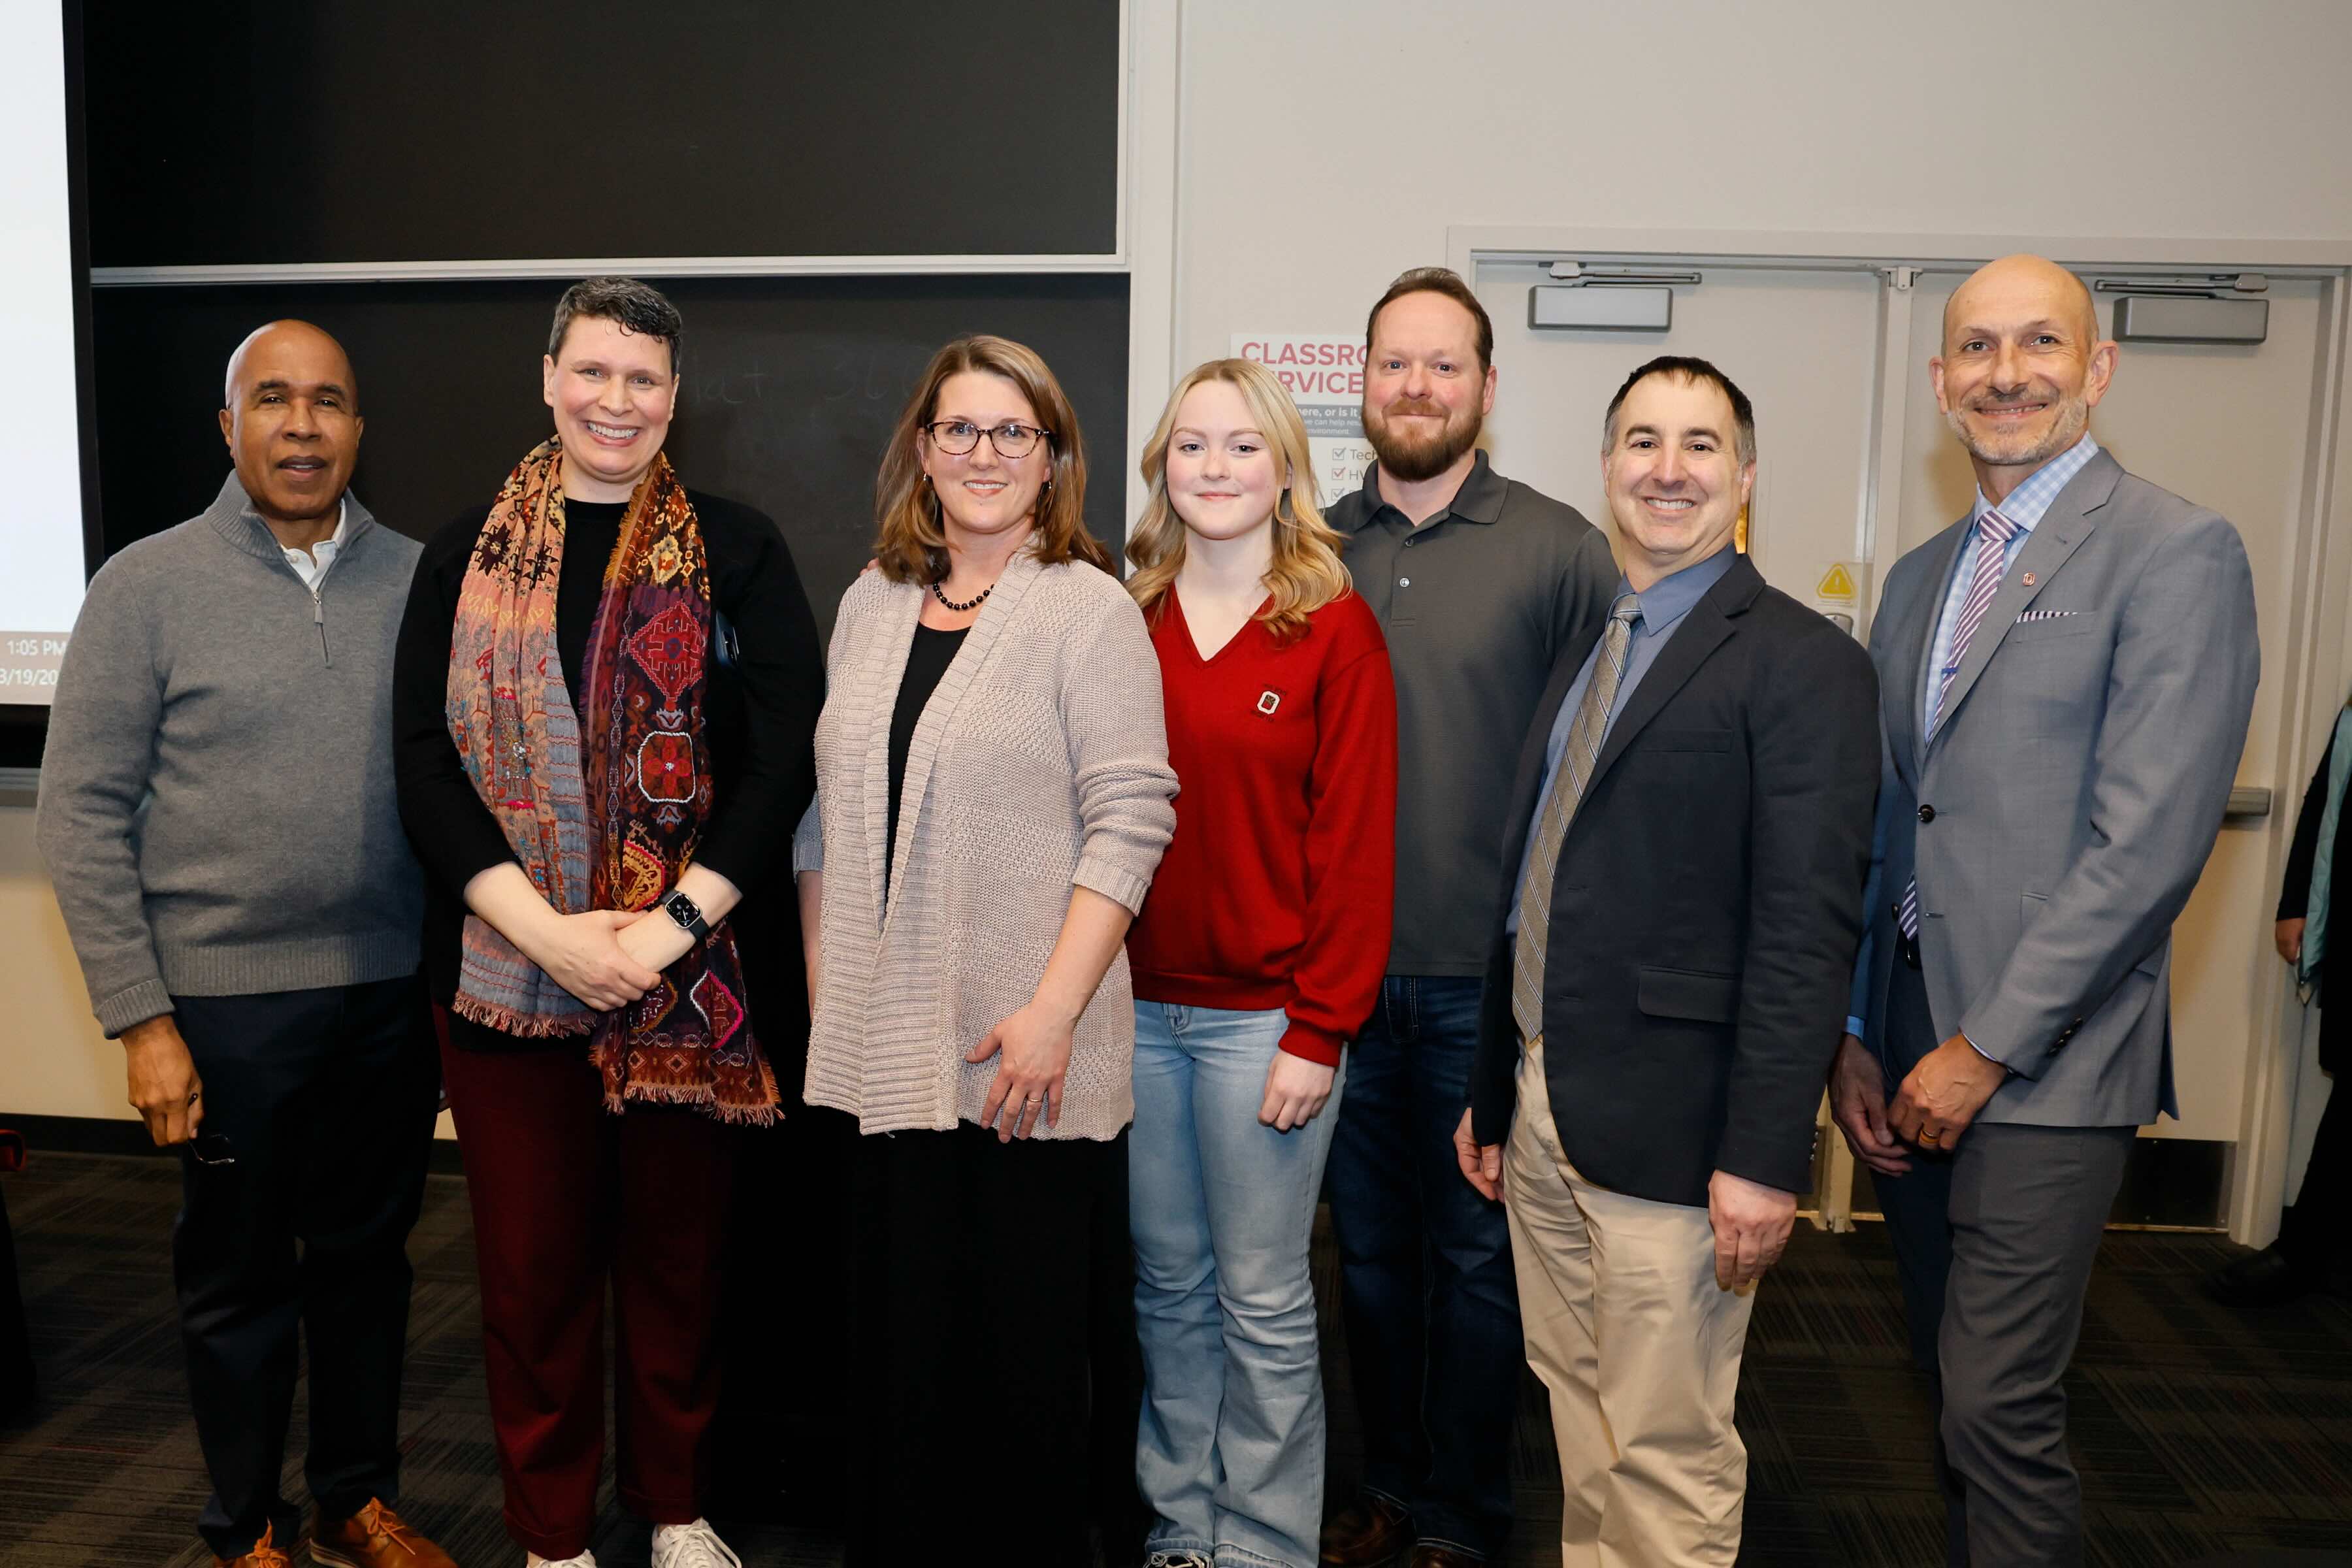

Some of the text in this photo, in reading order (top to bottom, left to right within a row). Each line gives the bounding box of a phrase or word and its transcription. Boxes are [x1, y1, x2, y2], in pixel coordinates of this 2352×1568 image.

[1273, 370, 1364, 393] RVICE
[6, 640, 67, 657] 1:05 PM
